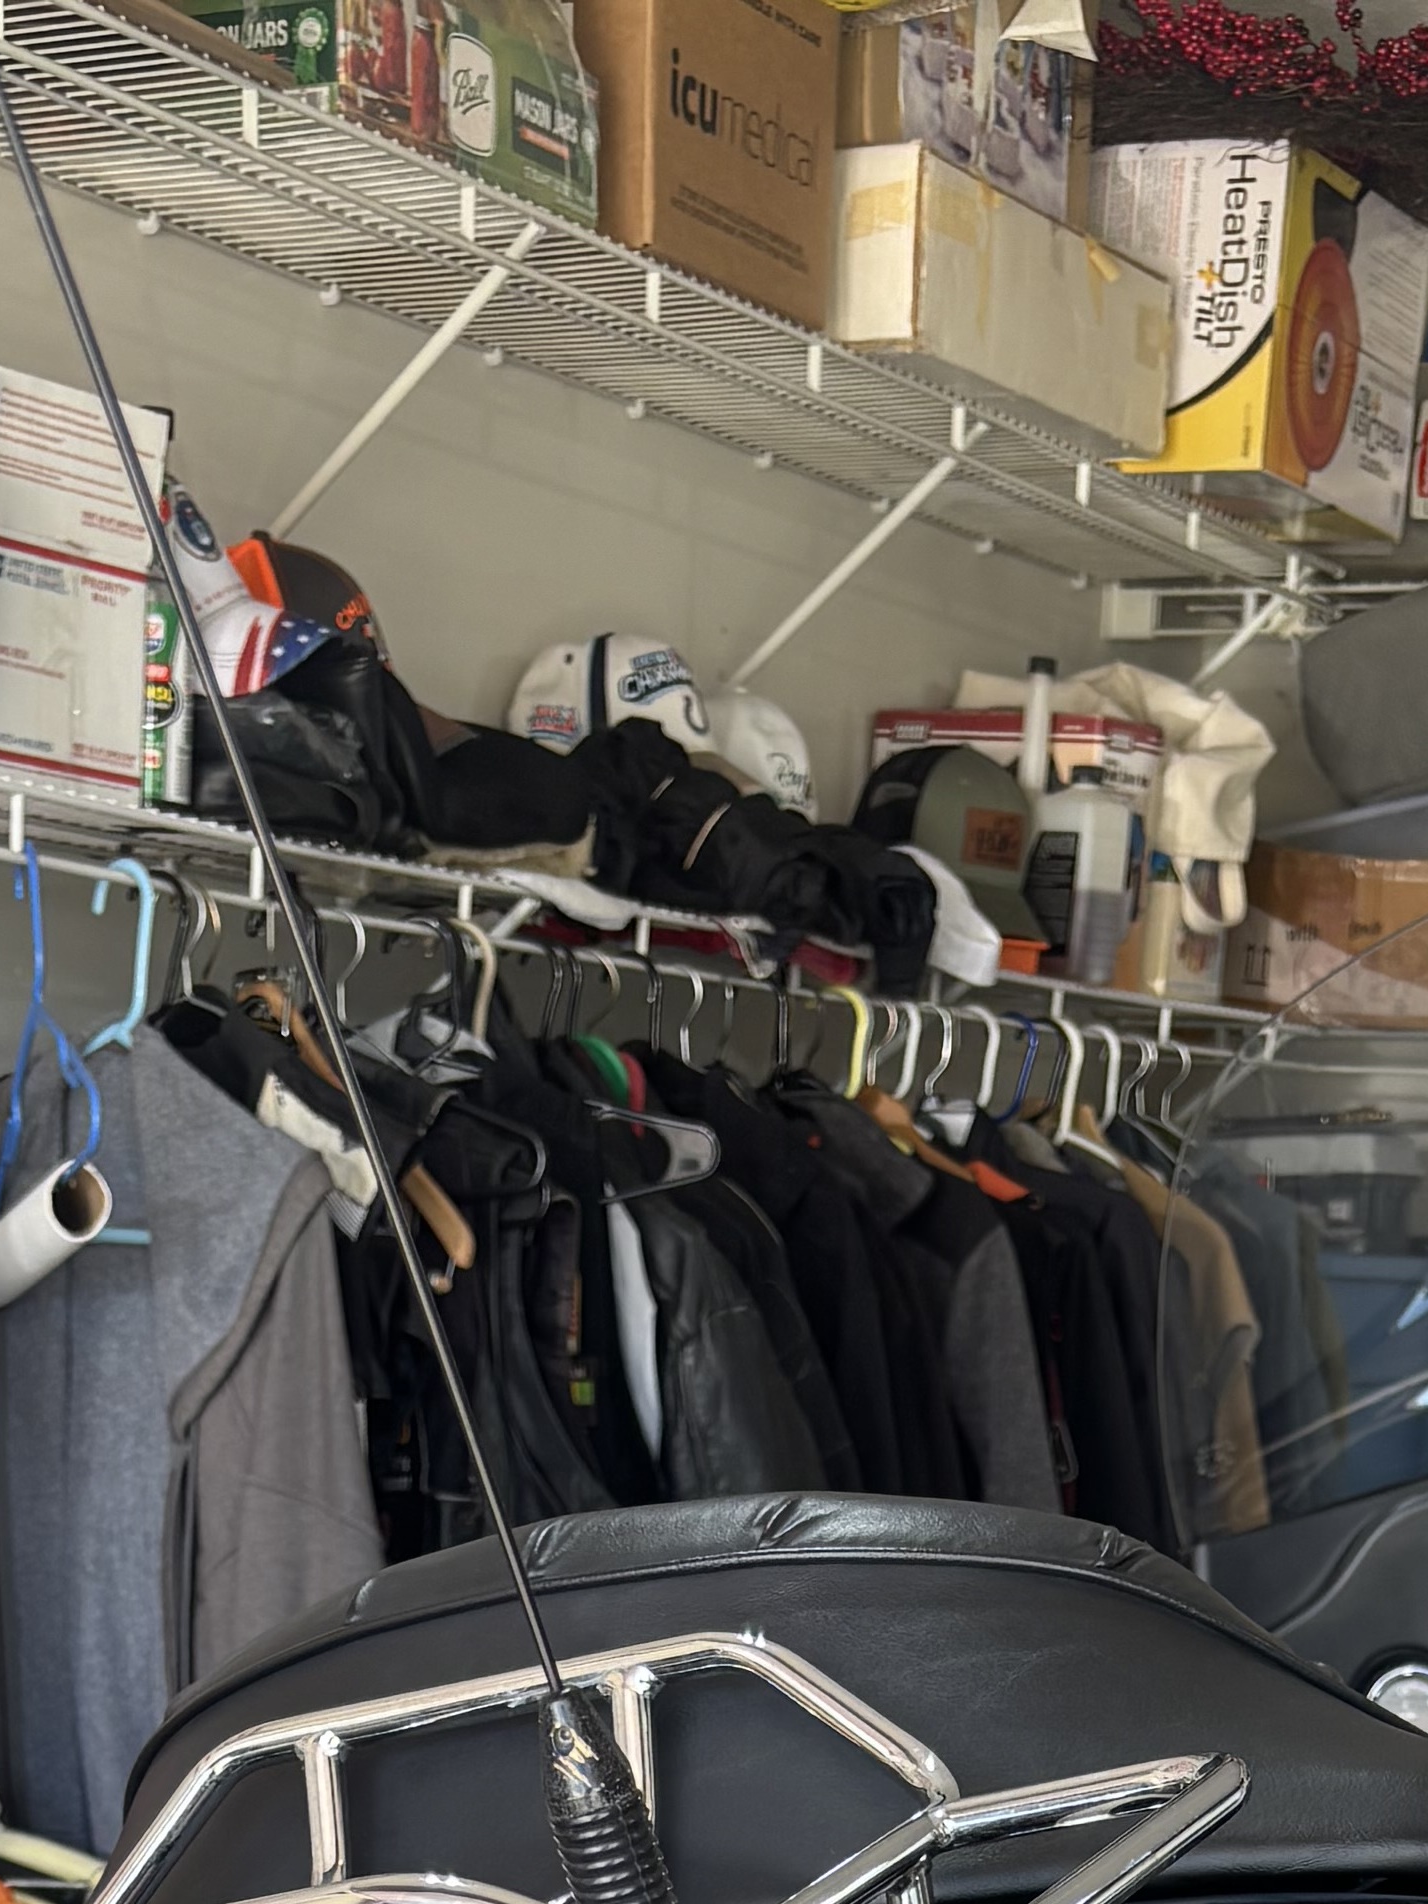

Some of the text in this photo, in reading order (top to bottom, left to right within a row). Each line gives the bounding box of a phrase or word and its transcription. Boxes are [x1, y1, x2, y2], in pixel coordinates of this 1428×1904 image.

[241, 19, 289, 50] JARS
[670, 47, 820, 192] icumedical
[1210, 154, 1258, 348] HeatDish
[1250, 200, 1273, 305] PRESTO
